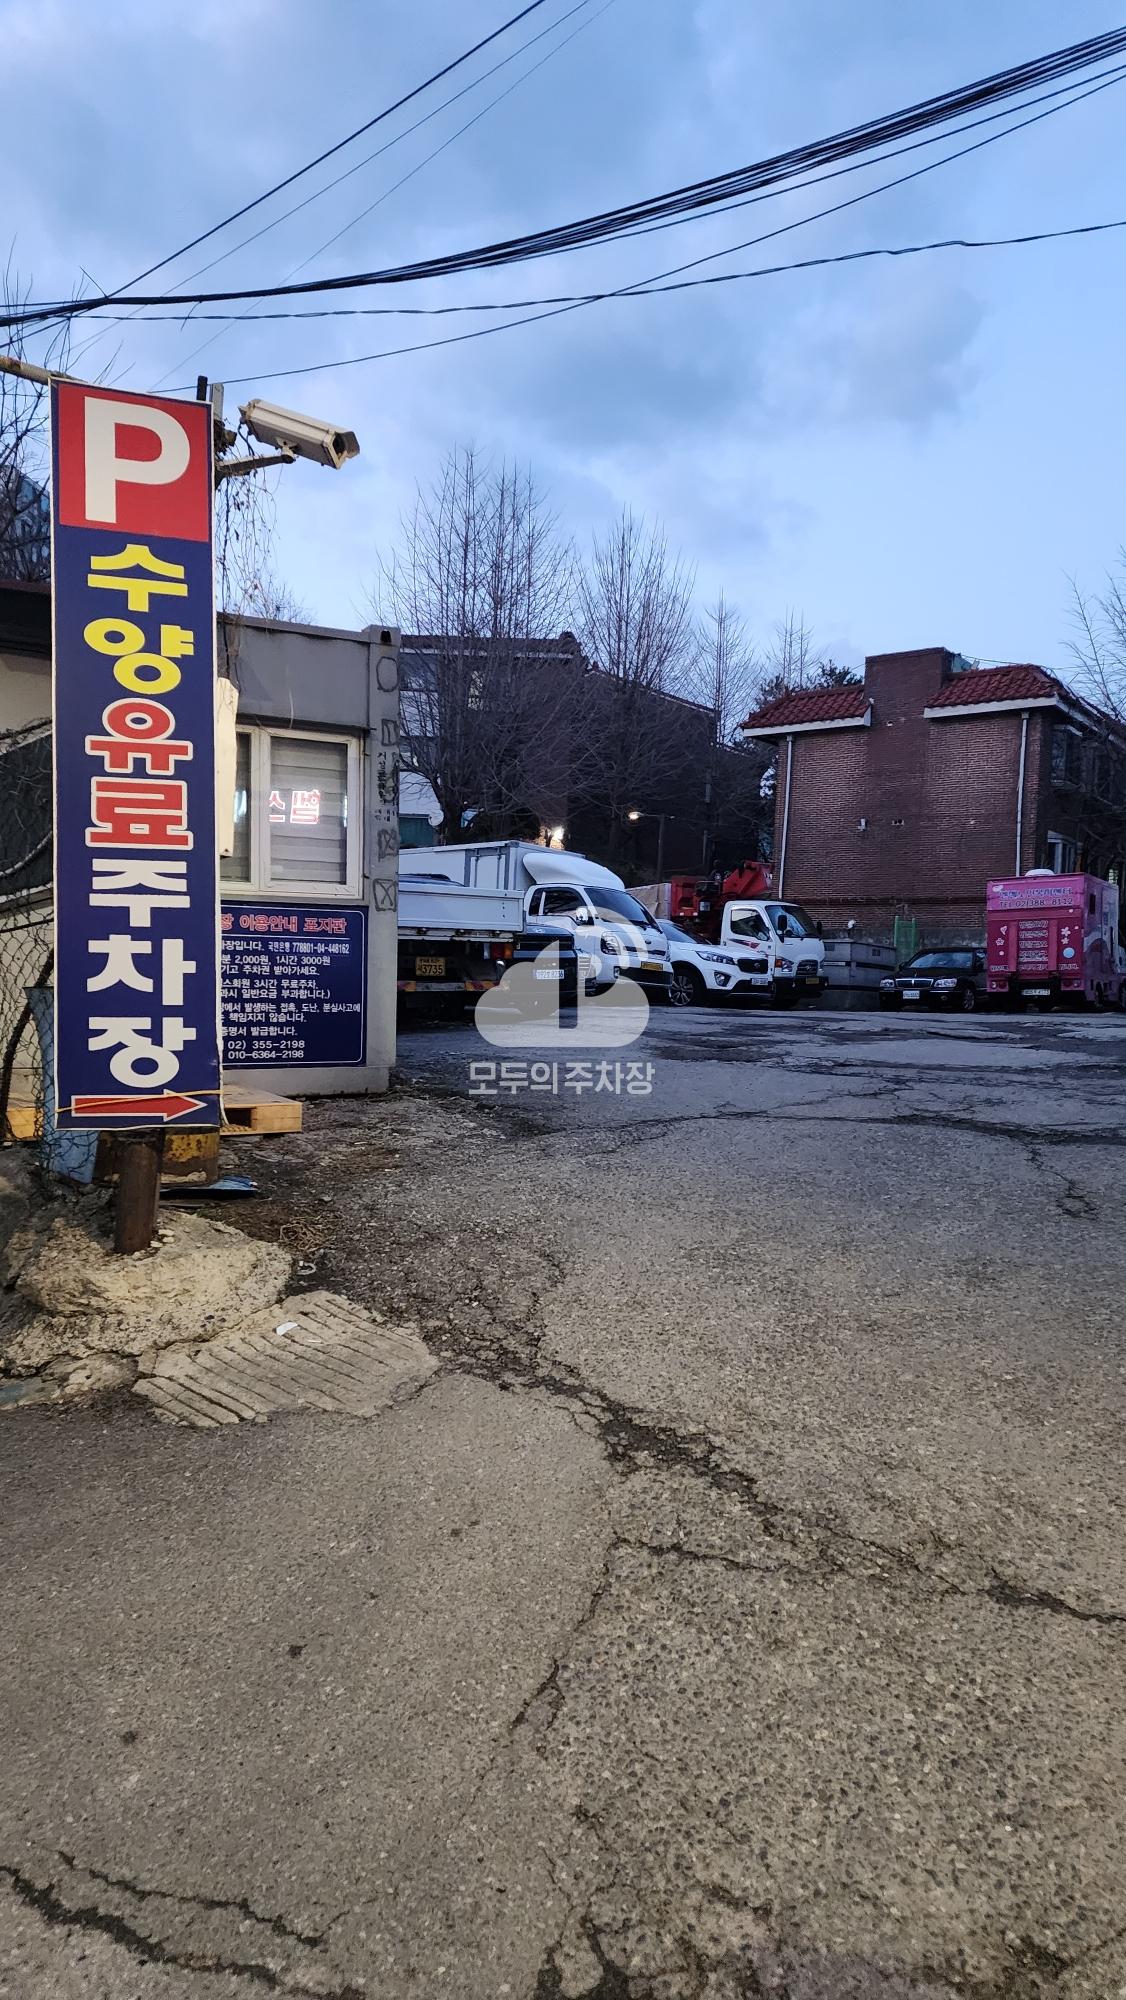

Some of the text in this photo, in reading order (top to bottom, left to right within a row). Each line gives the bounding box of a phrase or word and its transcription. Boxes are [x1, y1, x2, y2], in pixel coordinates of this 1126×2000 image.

[84, 395, 191, 524] P
[239, 914, 297, 933] 이용안내
[303, 918, 347, 934] 표지판
[276, 955, 298, 965] 1시간
[301, 956, 330, 966] 3000원
[243, 965, 270, 975] 주차권
[274, 965, 320, 976] 받아가세요.
[221, 978, 319, 990] 스회원 3시간 무료주차.
[242, 989, 277, 999] 일반요금
[244, 1002, 277, 1013] 발생하는
[323, 1003, 361, 1013] 분실사고에
[229, 1013, 265, 1023] 책임지지
[269, 1013, 307, 1023] 않습니다.
[251, 1026, 298, 1037] 발급합니다.
[228, 1040, 305, 1050] 02) 355-2198
[228, 1050, 304, 1060] 010-6364-2198
